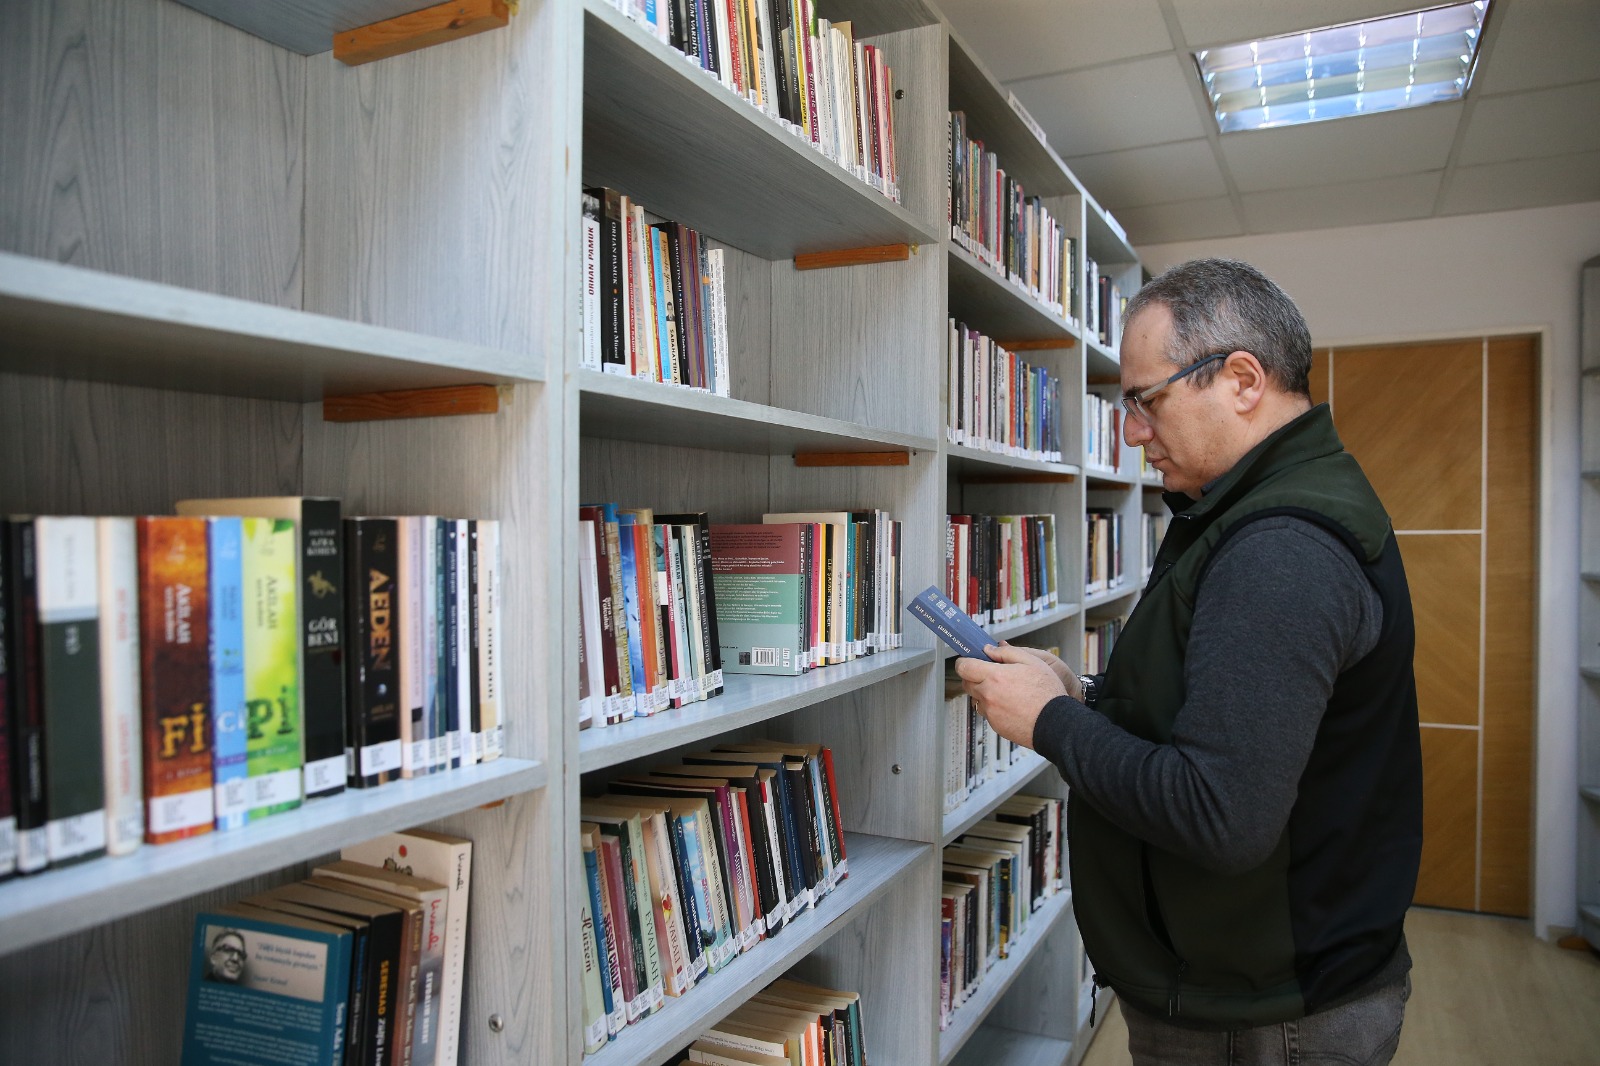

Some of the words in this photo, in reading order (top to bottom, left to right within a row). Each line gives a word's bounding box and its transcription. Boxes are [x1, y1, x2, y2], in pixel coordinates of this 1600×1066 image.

[308, 616, 336, 633] GÖR
[308, 630, 339, 647] BENİ
[364, 568, 396, 672] AEDEN
[604, 913, 614, 952] SESSİZ
[609, 953, 620, 993] ÇIĞLIK
[646, 910, 658, 982] EYVALLAH
[669, 920, 680, 964] YARALI
[377, 960, 389, 1016] SERENAD
[333, 1027, 343, 1051] Ada
[374, 1017, 386, 1046] Zülfü
